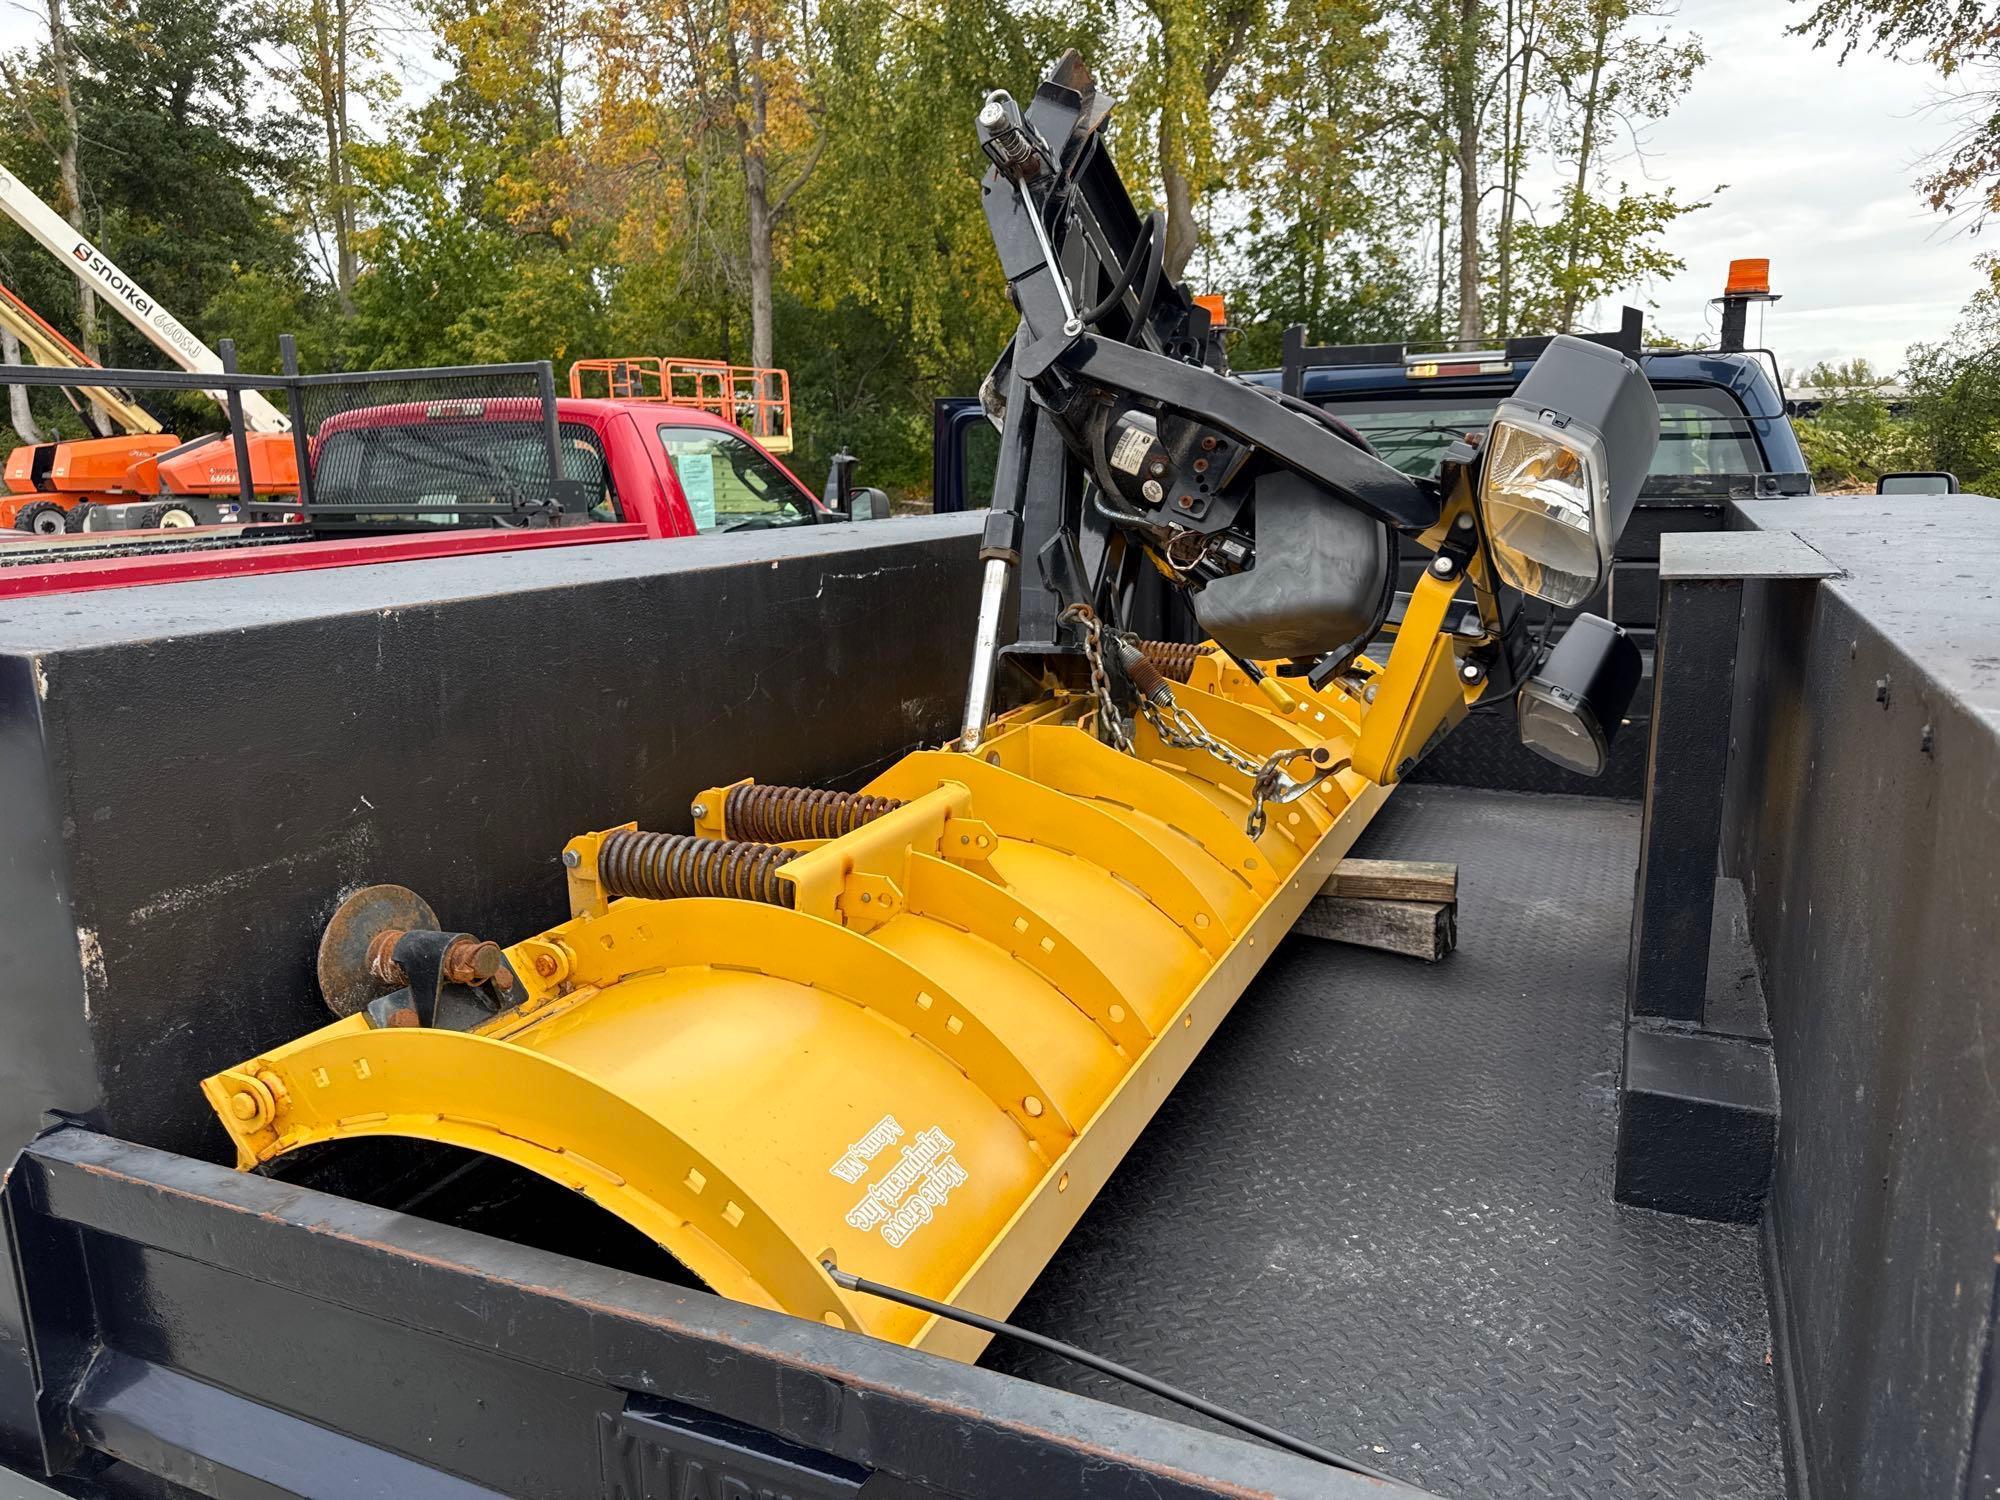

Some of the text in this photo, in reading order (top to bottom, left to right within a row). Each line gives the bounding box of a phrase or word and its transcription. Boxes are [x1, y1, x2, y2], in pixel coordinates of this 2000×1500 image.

[89, 257, 153, 317] snorkel
[153, 314, 202, 359] 660SJ
[830, 1115, 904, 1184] Adams, MA
[846, 1127, 955, 1231] Equipment, Inc.
[881, 1155, 967, 1247] Maple Grove
